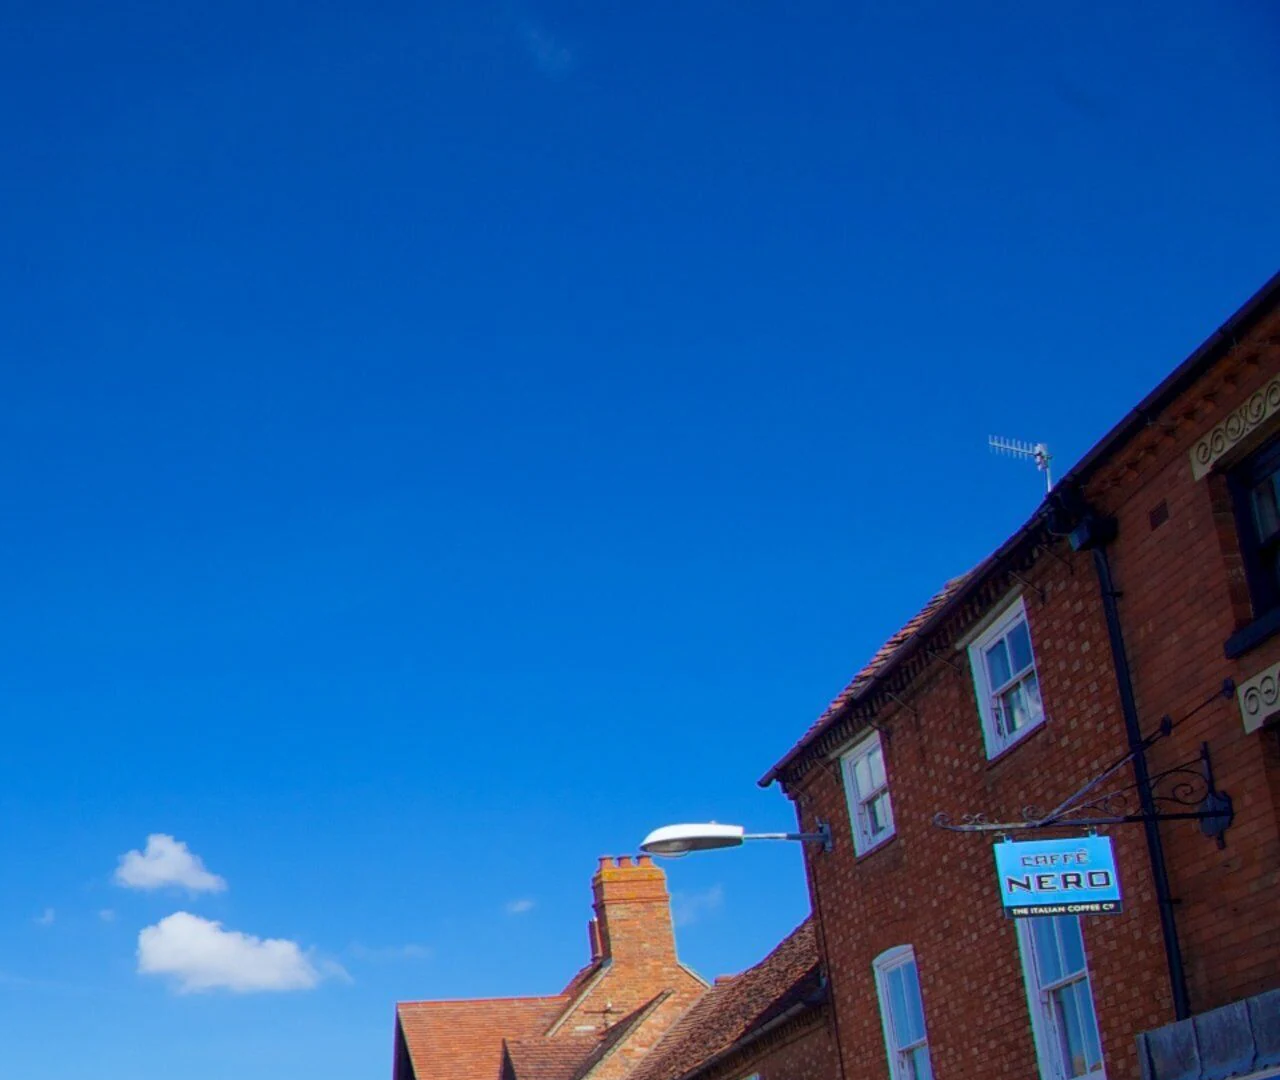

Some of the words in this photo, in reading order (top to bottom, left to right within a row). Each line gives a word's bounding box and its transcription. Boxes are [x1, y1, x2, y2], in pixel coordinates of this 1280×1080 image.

[1006, 870, 1111, 894] NERO
[1030, 906, 1065, 915] ITALIAN
[1067, 904, 1100, 913] COFFEE
